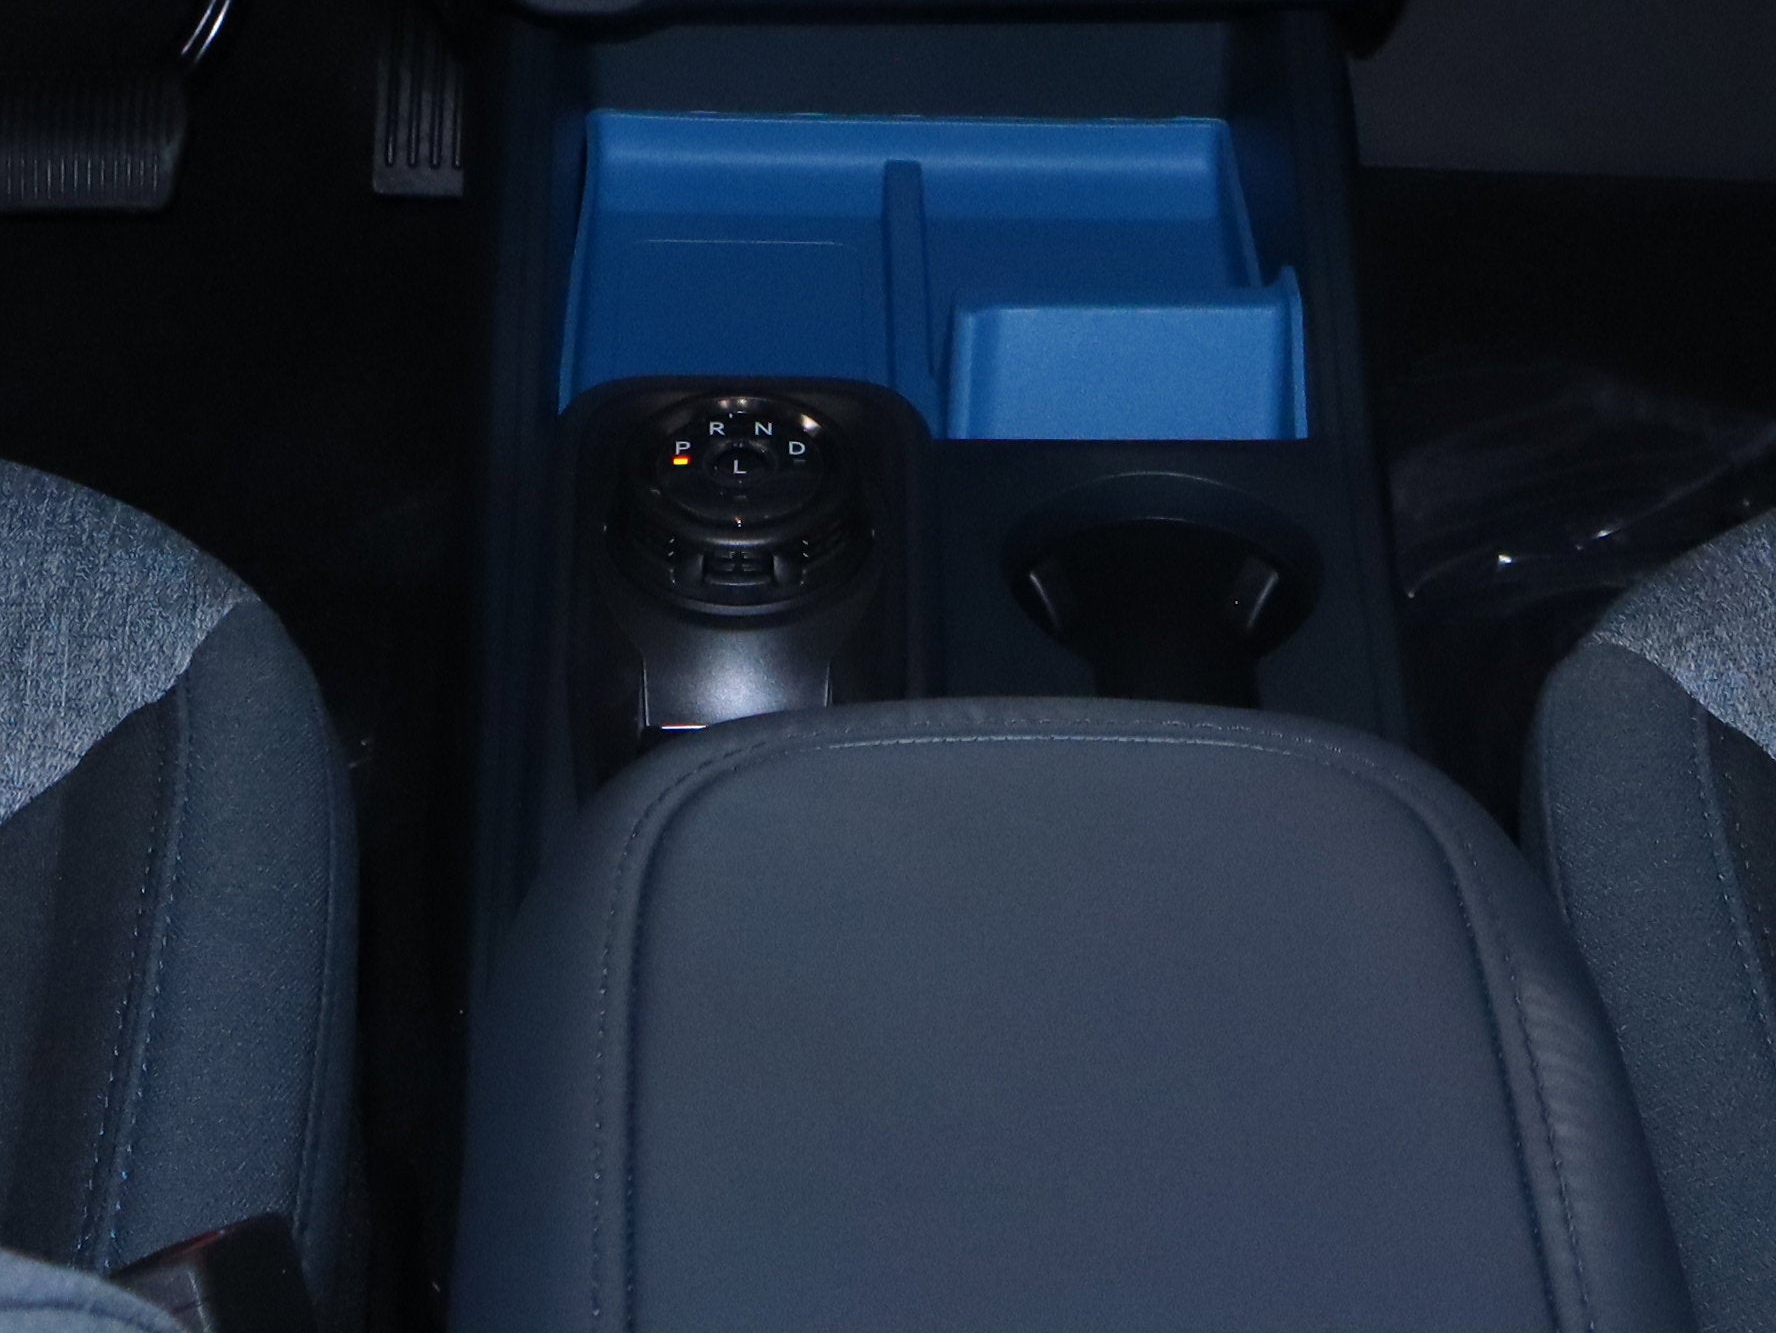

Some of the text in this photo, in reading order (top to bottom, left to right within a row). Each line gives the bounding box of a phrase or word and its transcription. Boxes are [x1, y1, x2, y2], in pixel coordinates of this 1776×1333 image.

[709, 421, 725, 436] R
[754, 421, 773, 436] N
[675, 441, 691, 455] P
[788, 441, 806, 455] D
[733, 459, 747, 474] L
